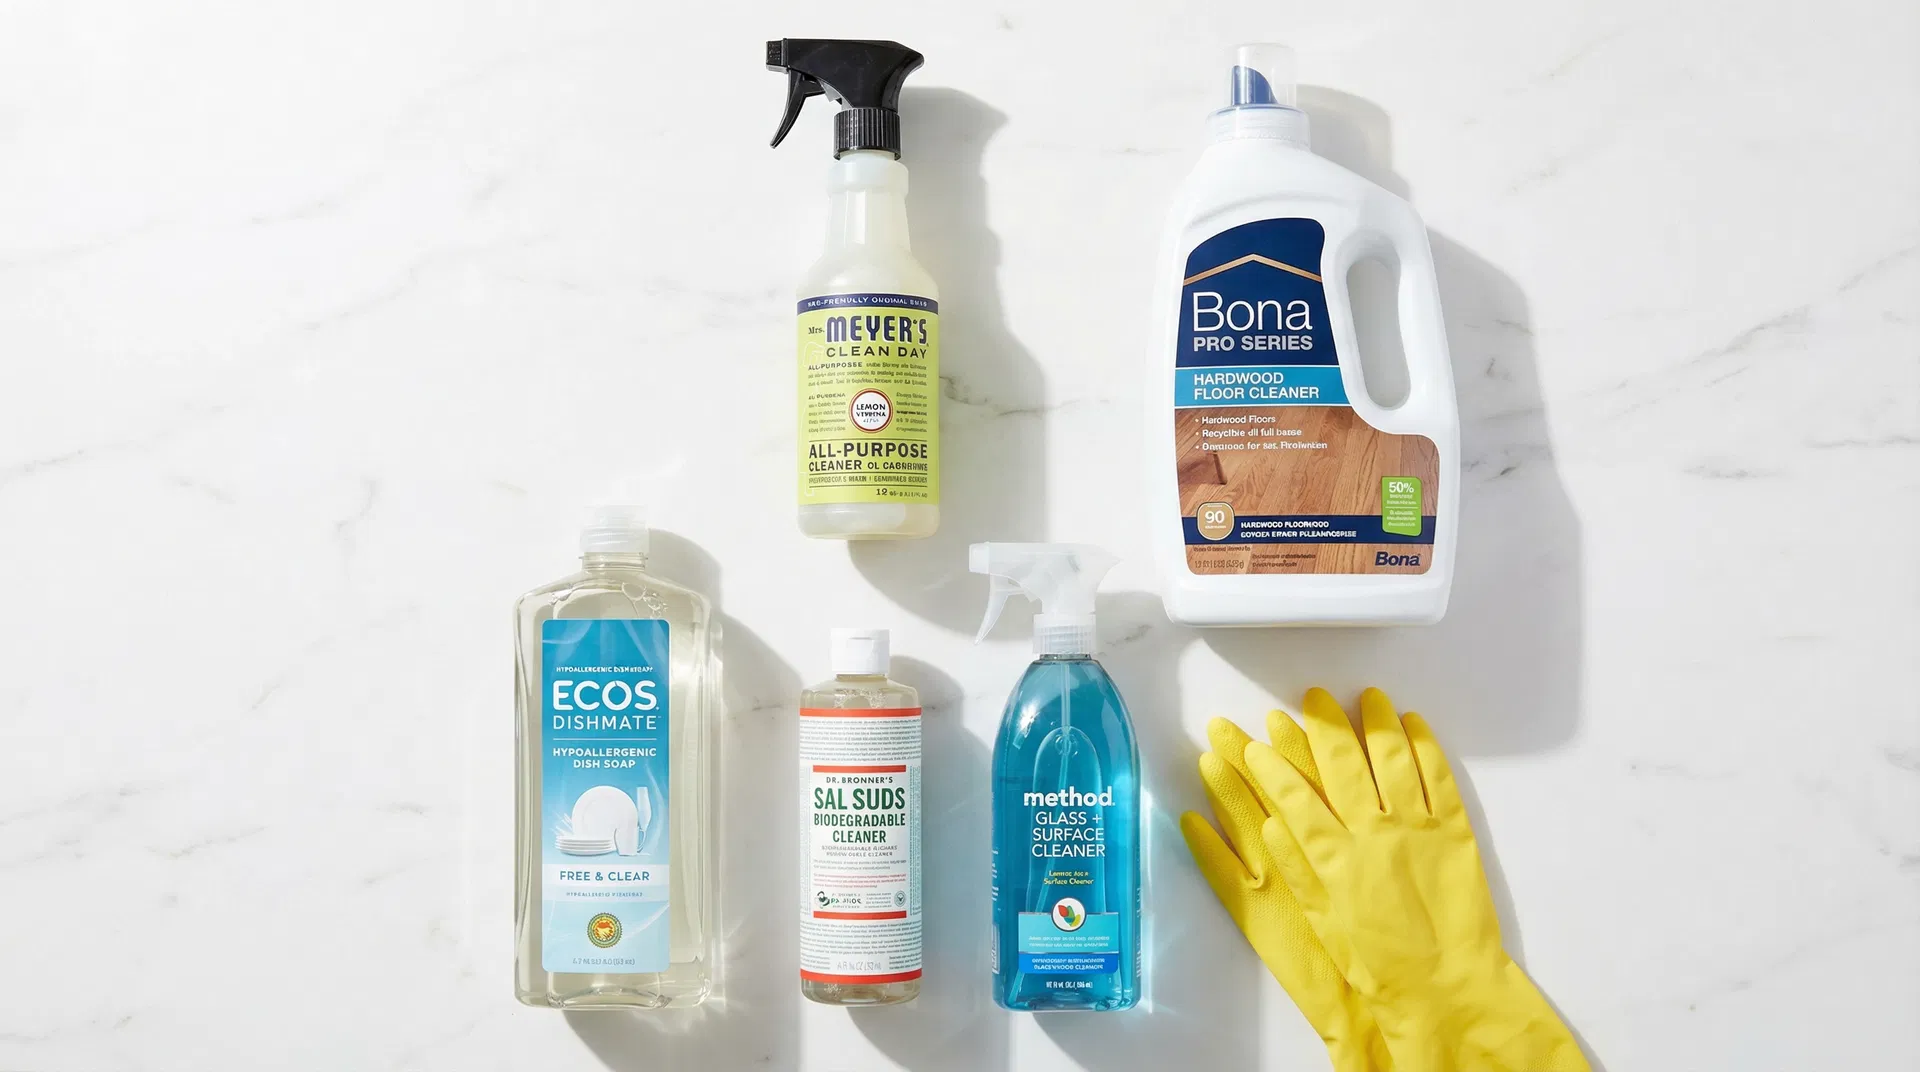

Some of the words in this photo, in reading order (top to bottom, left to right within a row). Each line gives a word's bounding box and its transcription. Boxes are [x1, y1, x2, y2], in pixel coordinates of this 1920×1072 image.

[1192, 291, 1313, 332] Bona
[808, 326, 825, 335] Mrs.
[826, 315, 928, 345] MEYER'S
[1193, 336, 1235, 352] PRO
[1241, 335, 1313, 351] SERIES
[826, 346, 890, 357] CLEAN
[897, 346, 927, 359] DAY
[1193, 372, 1284, 386] HARDWOOD
[1194, 387, 1245, 401] FLOOR
[1249, 386, 1319, 399] CLEANER
[856, 403, 886, 411] LEMON
[1201, 415, 1247, 425] Hardwood
[1260, 427, 1275, 436] full
[808, 442, 928, 459] ALL-PURPOSE
[808, 460, 862, 472] CLEANER
[876, 487, 888, 496] 12
[1388, 481, 1414, 493] 50%
[1204, 510, 1226, 524] 90
[1375, 551, 1421, 566] Bona
[552, 680, 657, 711] ECOS
[553, 715, 657, 730] DISHMATE
[553, 747, 657, 757] HYPOALLERGENIC
[573, 759, 601, 769] DISH
[603, 759, 636, 769] SOAP
[826, 776, 840, 784] DR.
[841, 776, 894, 784] BRONNER'S
[814, 787, 848, 810] SAL
[852, 787, 906, 811] SUDS
[1023, 786, 1113, 807] method
[814, 812, 906, 827] BIODEGRADABLE
[1035, 811, 1087, 825] GLASS
[1092, 813, 1102, 824] +
[832, 829, 887, 843] CLEANER
[1032, 827, 1105, 842] SURFACE
[1031, 844, 1106, 858] CLEANER
[559, 870, 591, 881] FREE
[595, 871, 604, 881] &
[607, 871, 650, 881] CLEAR
